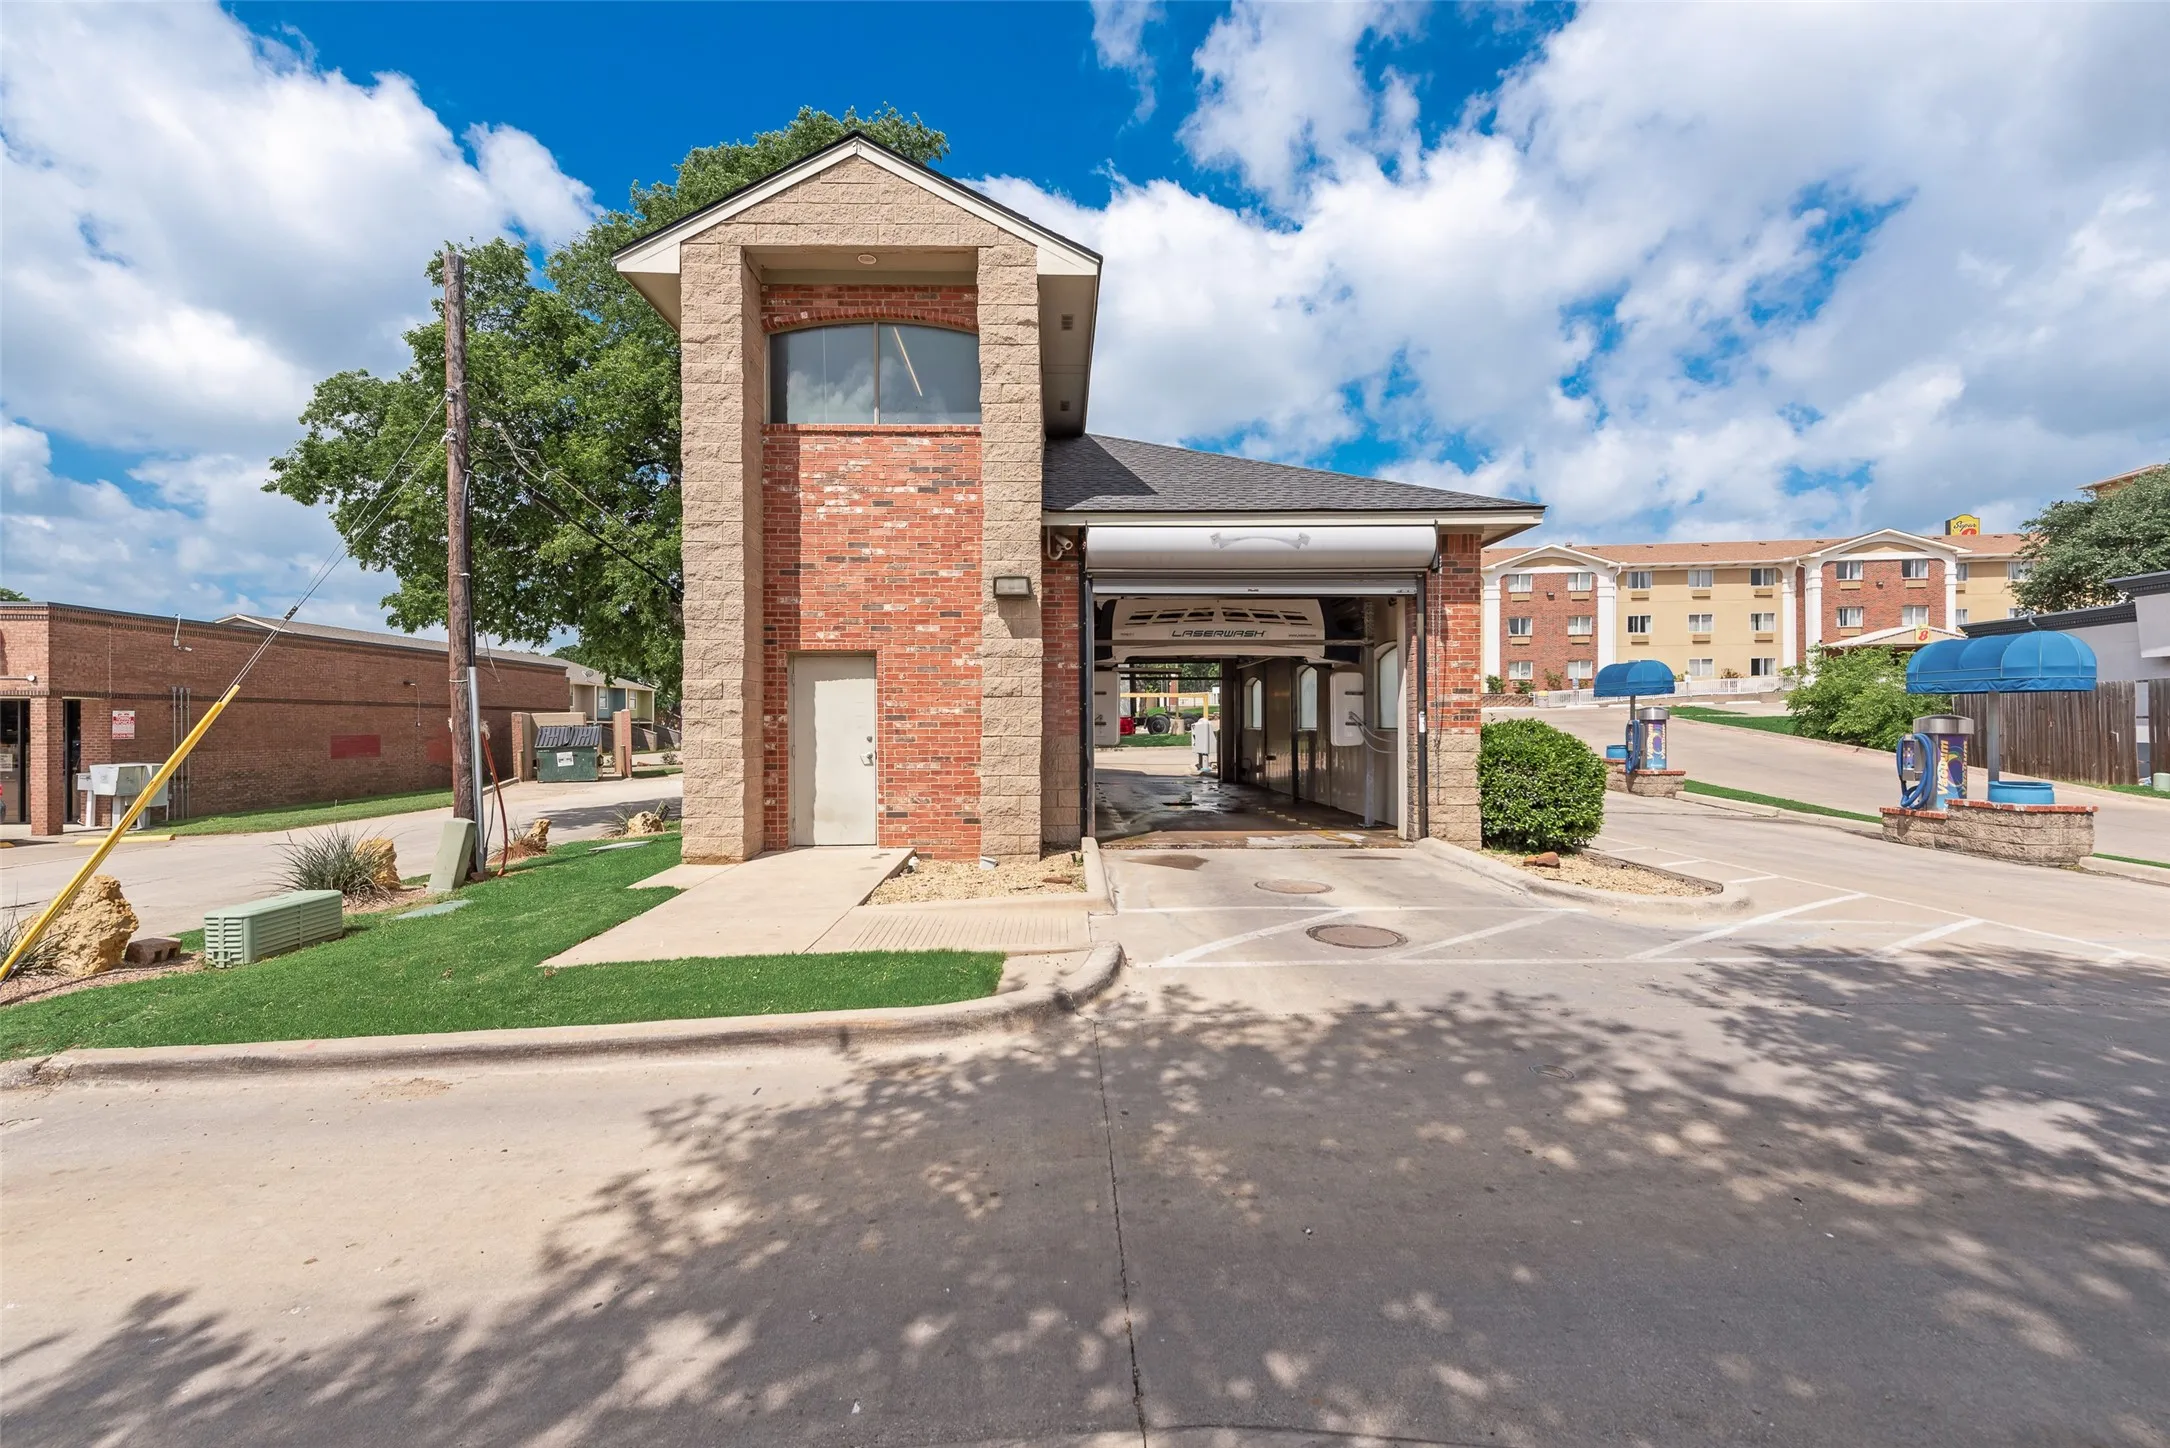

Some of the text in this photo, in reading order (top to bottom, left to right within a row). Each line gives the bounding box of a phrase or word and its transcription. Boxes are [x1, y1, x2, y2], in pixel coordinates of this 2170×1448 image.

[1953, 520, 1977, 532] Super
[1172, 630, 1265, 638] LASERWASH
[1918, 630, 1929, 641] 8
[1646, 723, 1654, 760] Vacuum
[1937, 740, 1949, 795] Vacuum
